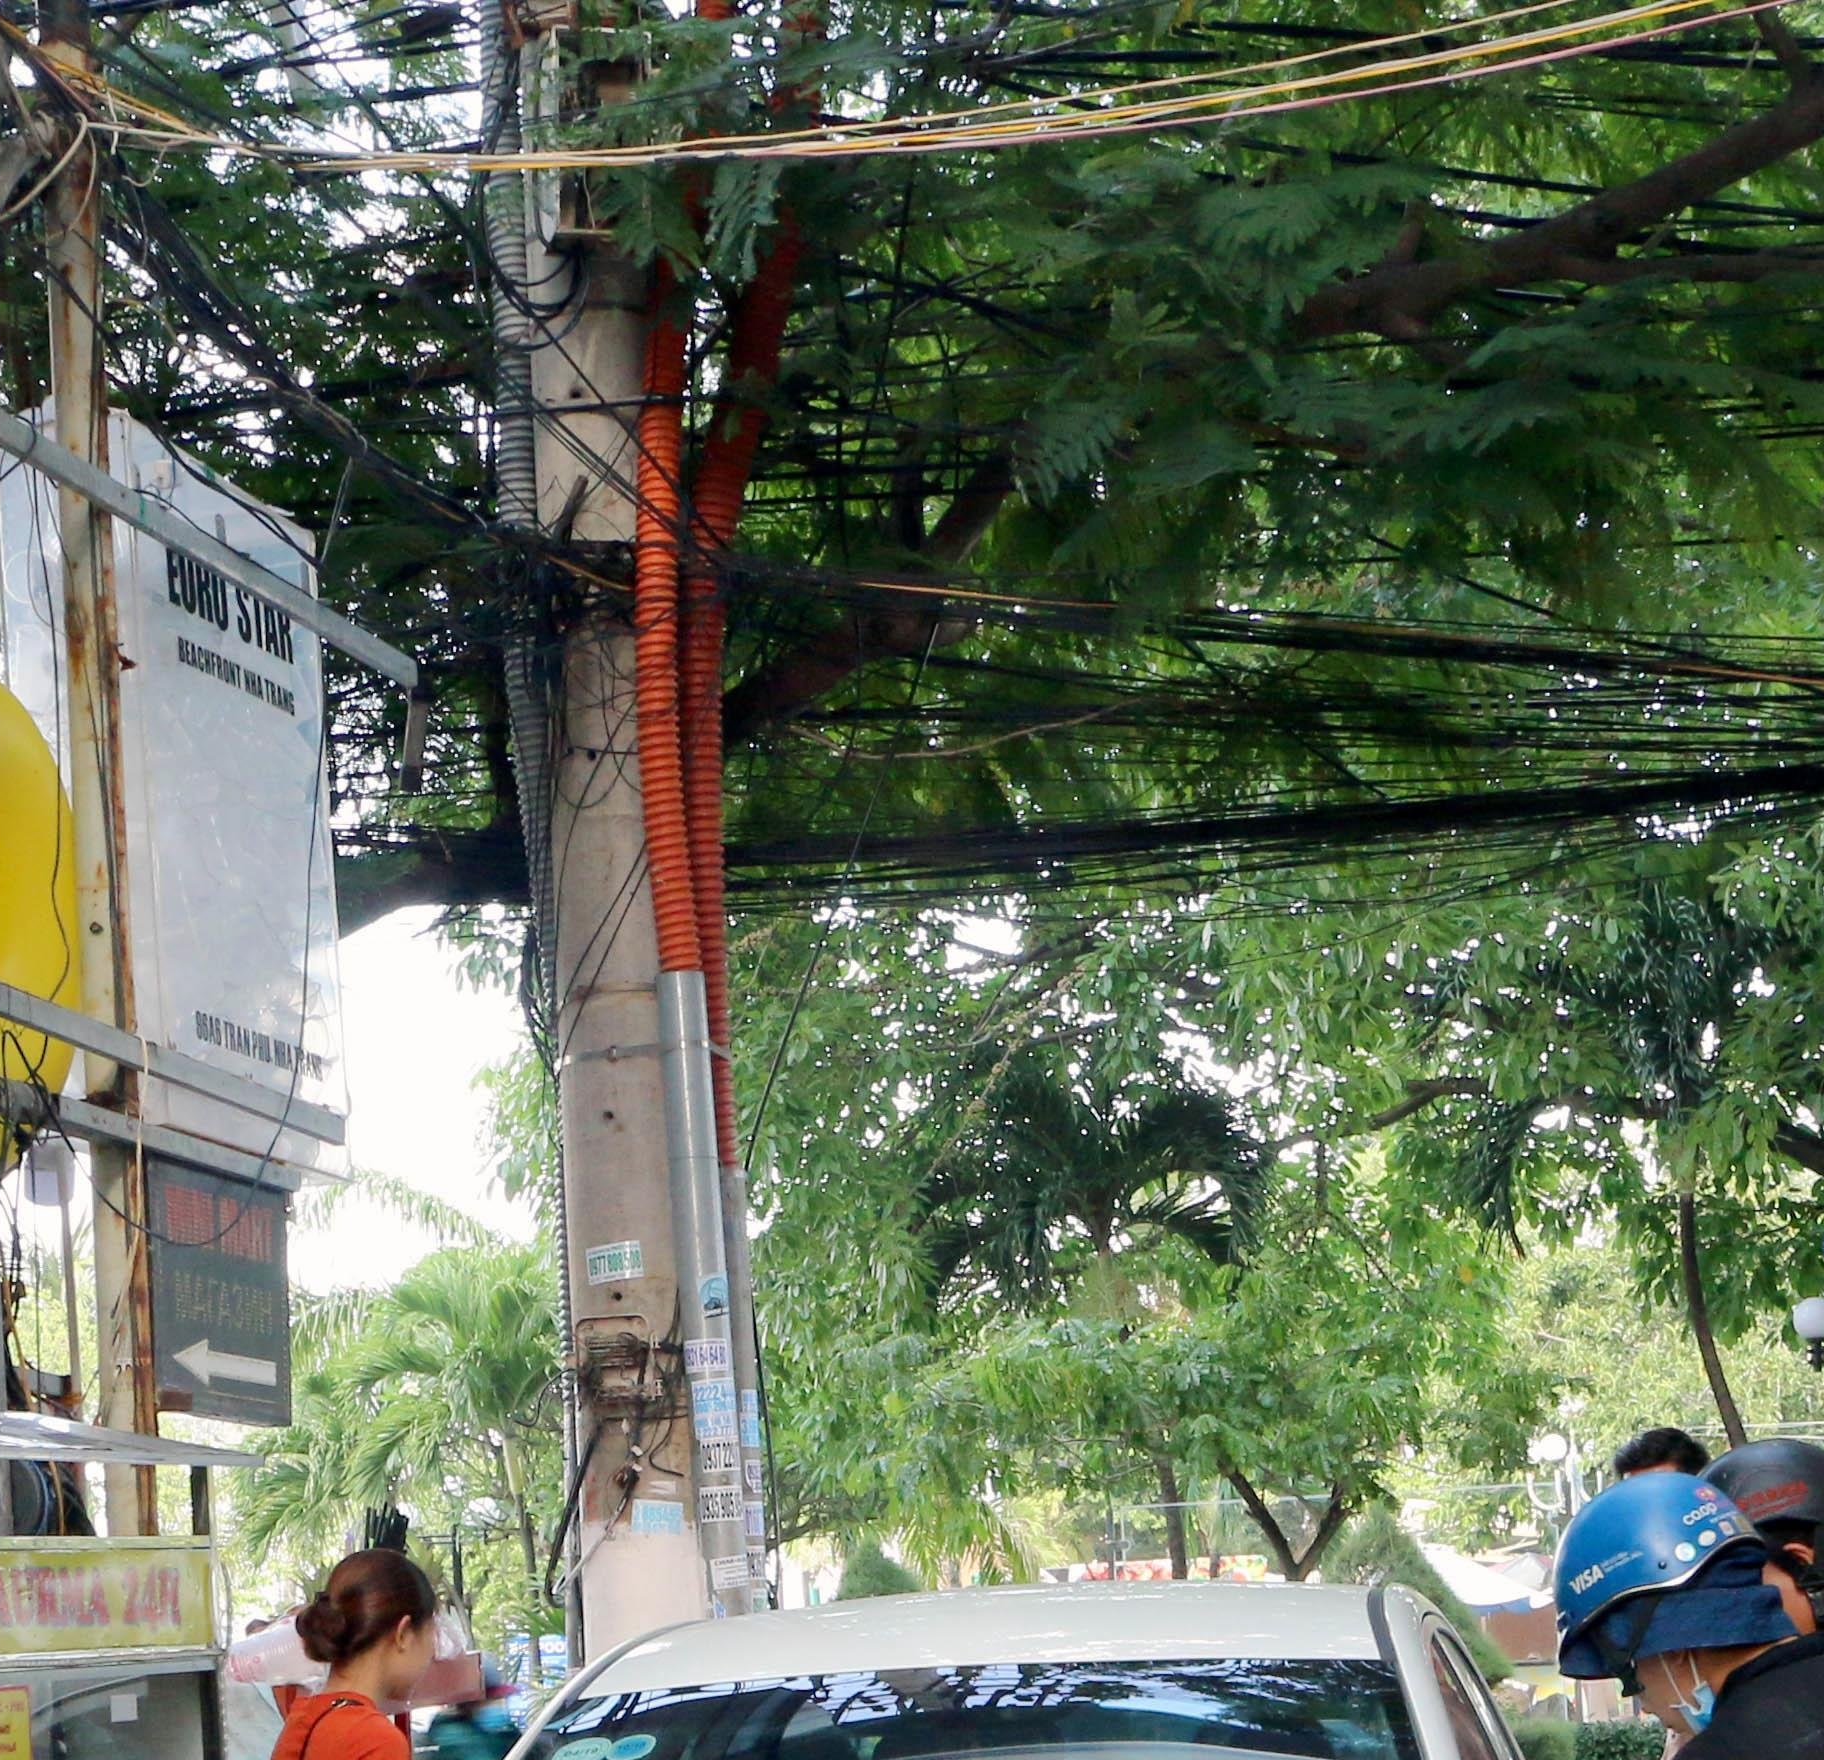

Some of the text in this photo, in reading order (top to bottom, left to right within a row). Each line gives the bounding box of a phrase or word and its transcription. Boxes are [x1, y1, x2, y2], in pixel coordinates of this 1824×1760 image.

[166, 550, 295, 665] EURO STAR
[177, 636, 242, 690] BEACHFRONT
[244, 669, 264, 701] NHA
[223, 1020, 250, 1058] TRAN
[1569, 1563, 1605, 1595] VISA
